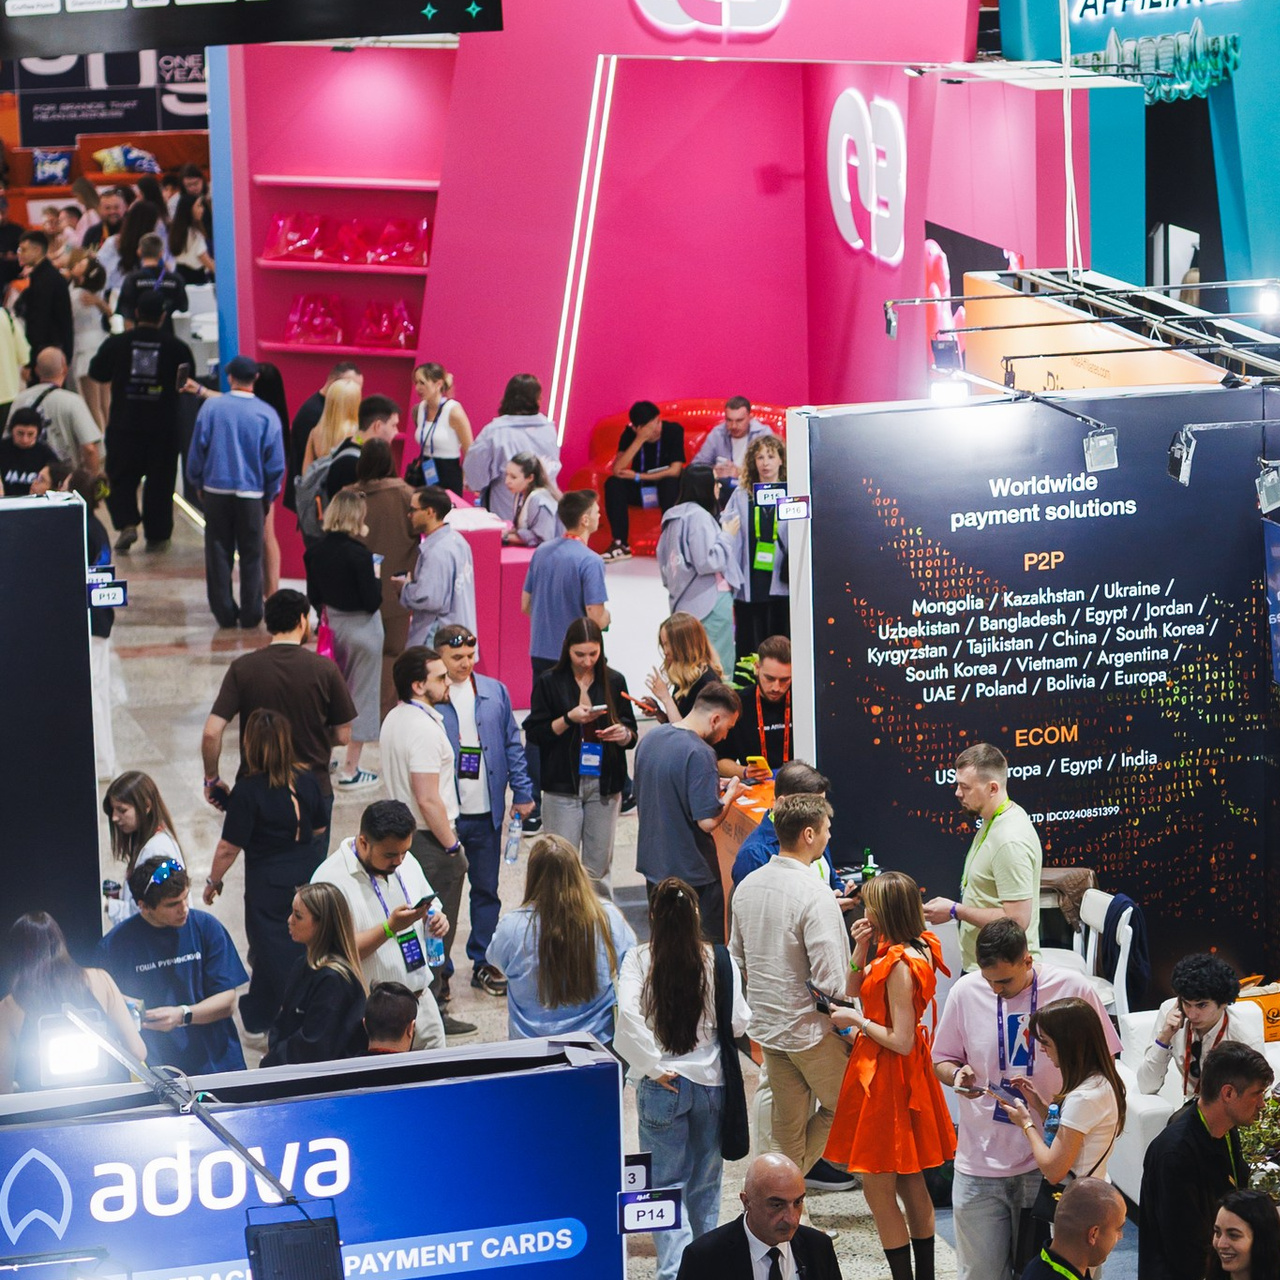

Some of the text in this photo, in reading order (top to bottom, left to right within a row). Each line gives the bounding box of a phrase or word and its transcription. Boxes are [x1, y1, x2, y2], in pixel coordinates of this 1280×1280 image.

[988, 473, 1098, 498] Worldwide
[950, 497, 1137, 531] payment solutions
[1023, 551, 1064, 572] P2P
[912, 581, 1161, 616] Mongolia Kazakhstan Ukraine
[878, 599, 1194, 641] Uzbekistan Bangladesh Egypt Jordan
[867, 619, 1205, 667] Kyrgyzstan Tajikistan China South Korea
[905, 644, 1169, 683] South Korea Vietnam Argentina
[922, 667, 1167, 703] UAE Poland Bolivia Europa
[1015, 724, 1079, 748] ECOM
[1006, 750, 1158, 781] ropa Egypt India
[1046, 805, 1120, 823] IDC0240851399
[89, 1135, 351, 1223] adova
[635, 1206, 666, 1224] P14
[343, 1227, 574, 1279] PAYMENT CARDS
